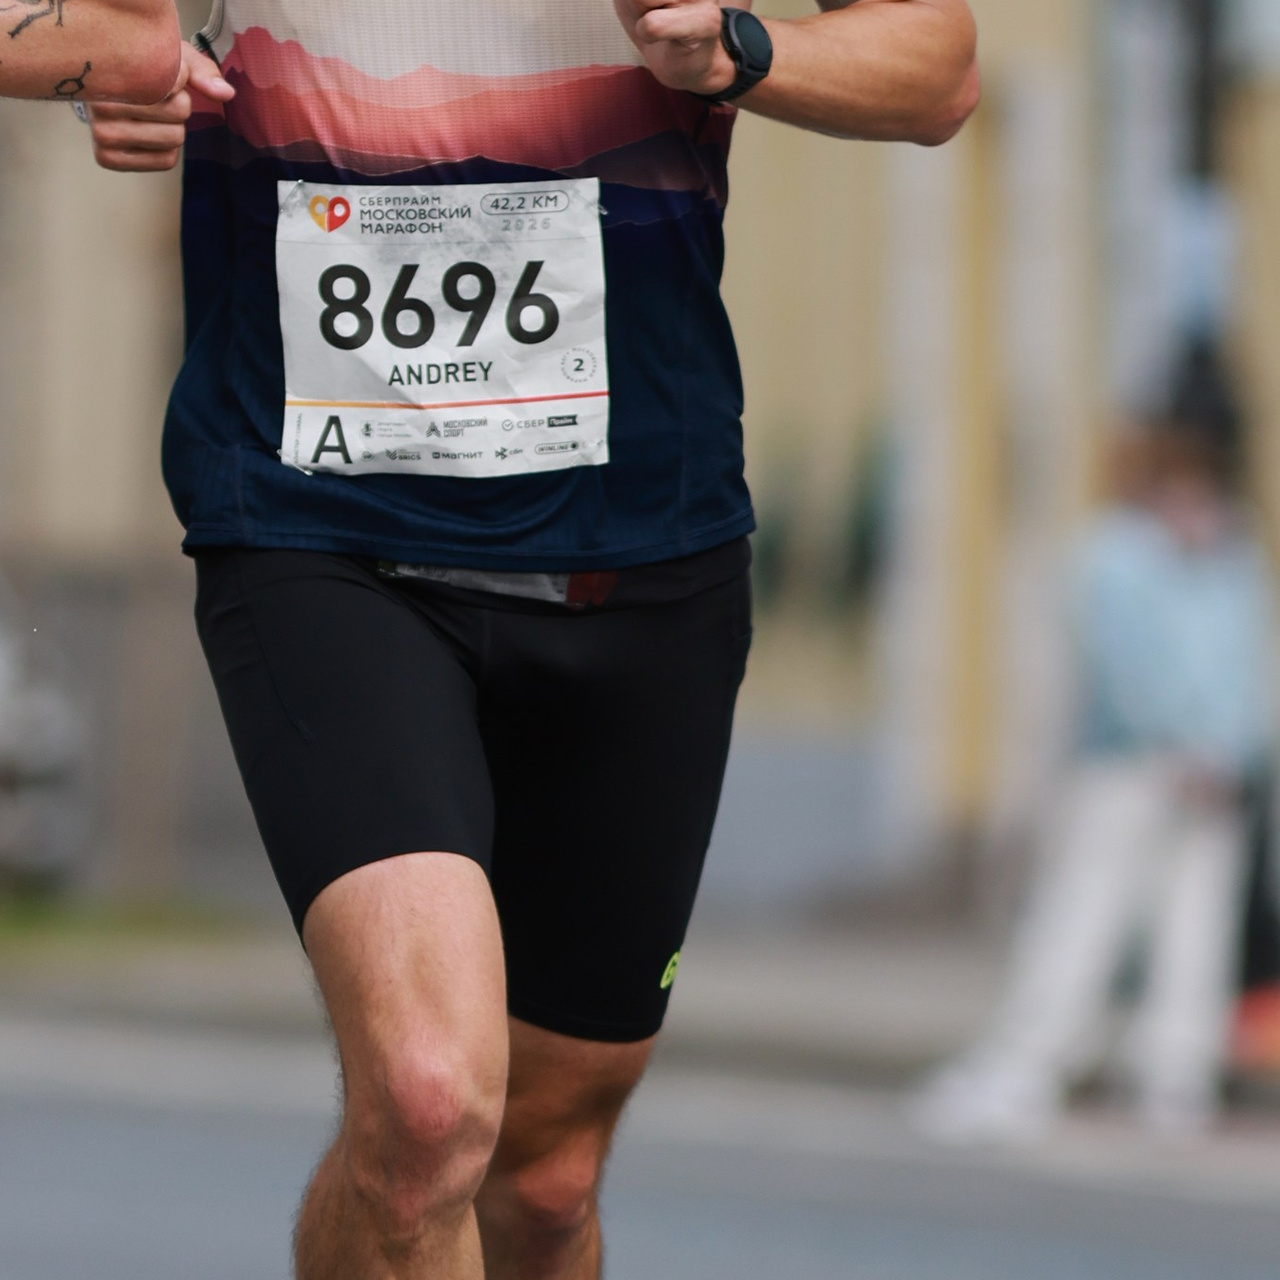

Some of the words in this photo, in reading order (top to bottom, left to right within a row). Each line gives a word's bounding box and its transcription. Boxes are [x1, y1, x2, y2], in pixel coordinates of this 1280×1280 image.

[359, 195, 441, 206] СБЕРПРАЙМ
[490, 197, 526, 211] 42,2
[360, 205, 471, 220] МОСКОВСКИЙ
[361, 222, 443, 234] МАРАФОН
[318, 260, 560, 351] 8696
[573, 358, 584, 372] 2
[388, 361, 494, 387] ANDREY
[443, 416, 488, 427] МОСКОВСКИЙ
[517, 419, 545, 429] СБЕР
